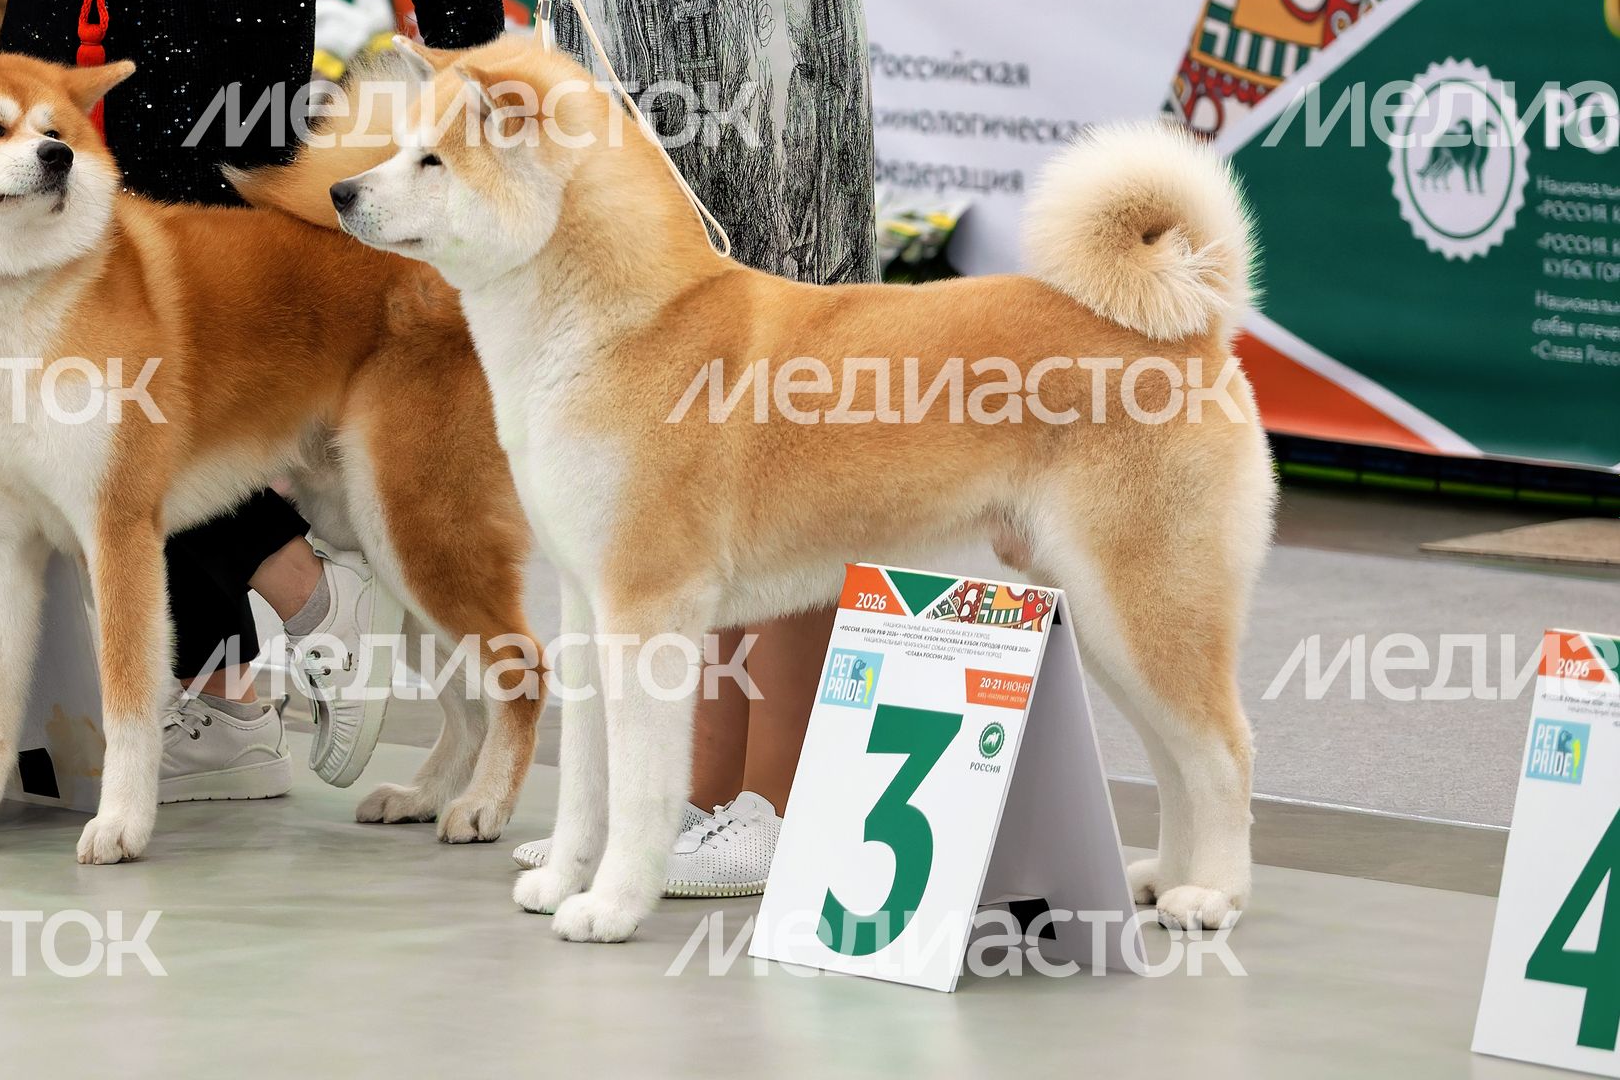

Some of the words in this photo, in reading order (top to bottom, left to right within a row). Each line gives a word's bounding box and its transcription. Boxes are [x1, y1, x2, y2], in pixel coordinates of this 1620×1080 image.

[855, 592, 887, 610] 2026
[831, 653, 855, 677] PET
[1556, 657, 1589, 678] 2026
[1002, 680, 1030, 693] ИЮНЯ
[1535, 723, 1562, 750] PET
[969, 762, 1001, 773] РОССИЯ
[815, 703, 964, 957] 3
[1524, 808, 1620, 1052] 4
